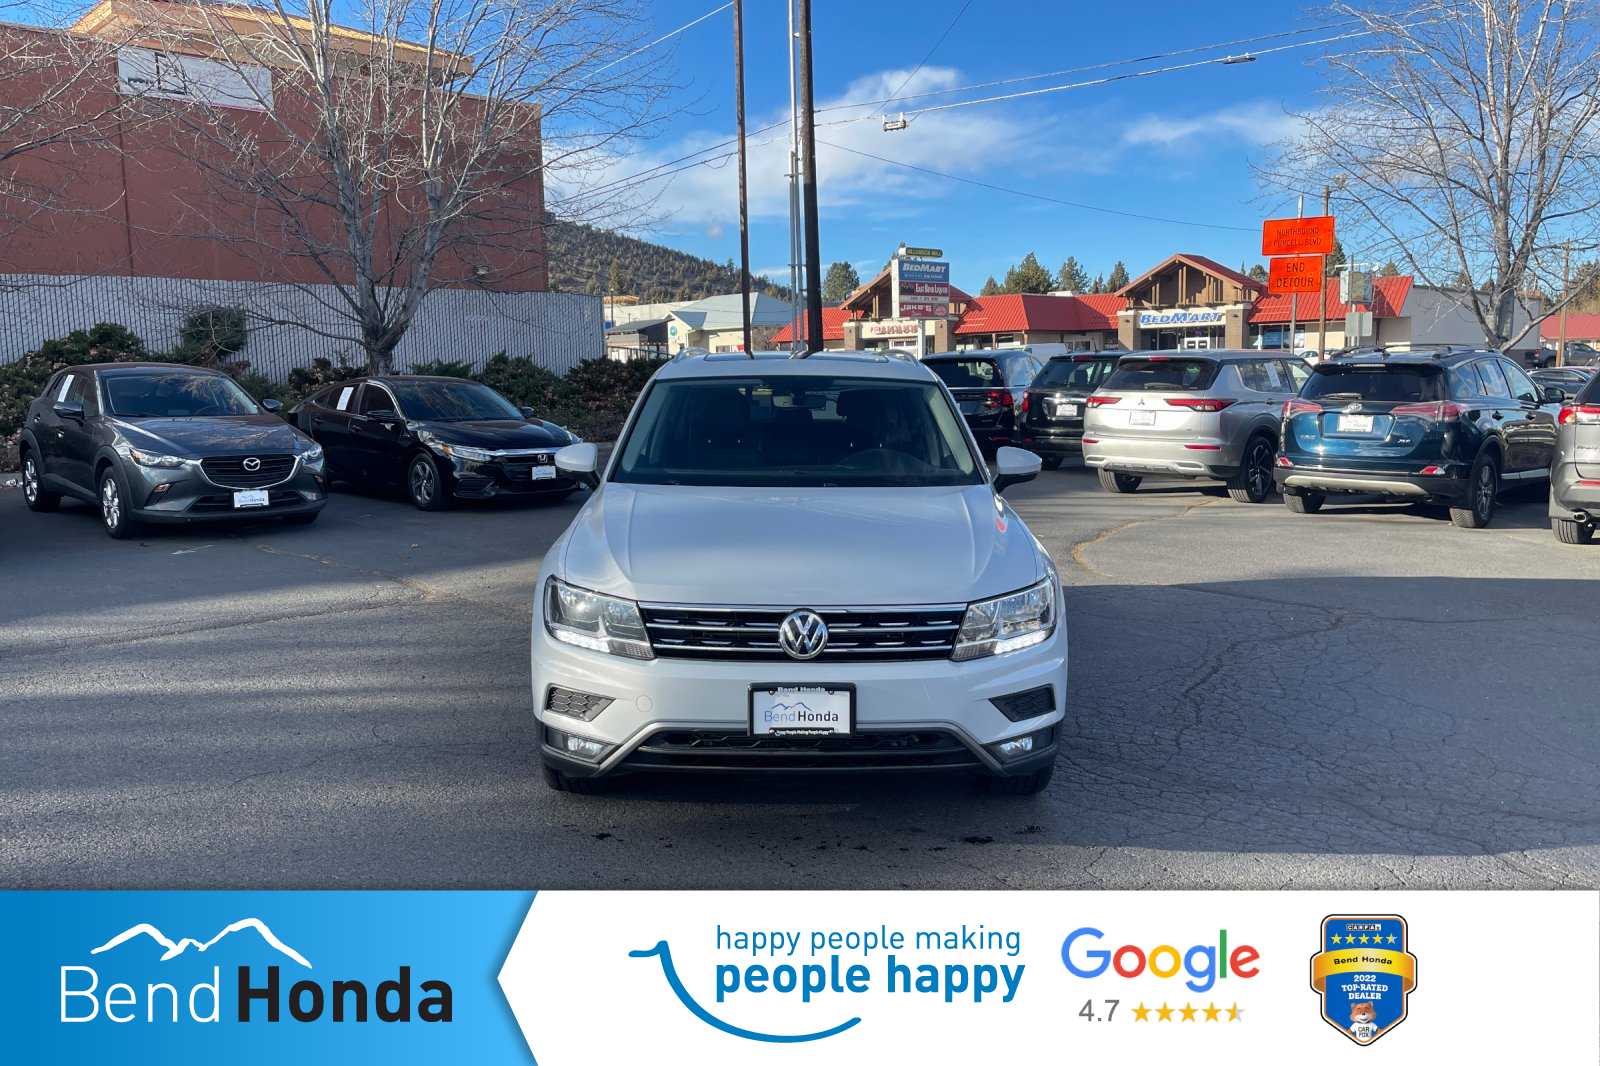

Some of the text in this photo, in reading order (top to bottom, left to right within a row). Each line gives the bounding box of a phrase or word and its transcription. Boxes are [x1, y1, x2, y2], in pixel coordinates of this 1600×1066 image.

[1286, 262, 1305, 273] END
[1276, 276, 1314, 288] DETOUR
[764, 710, 839, 722] Bend Honda
